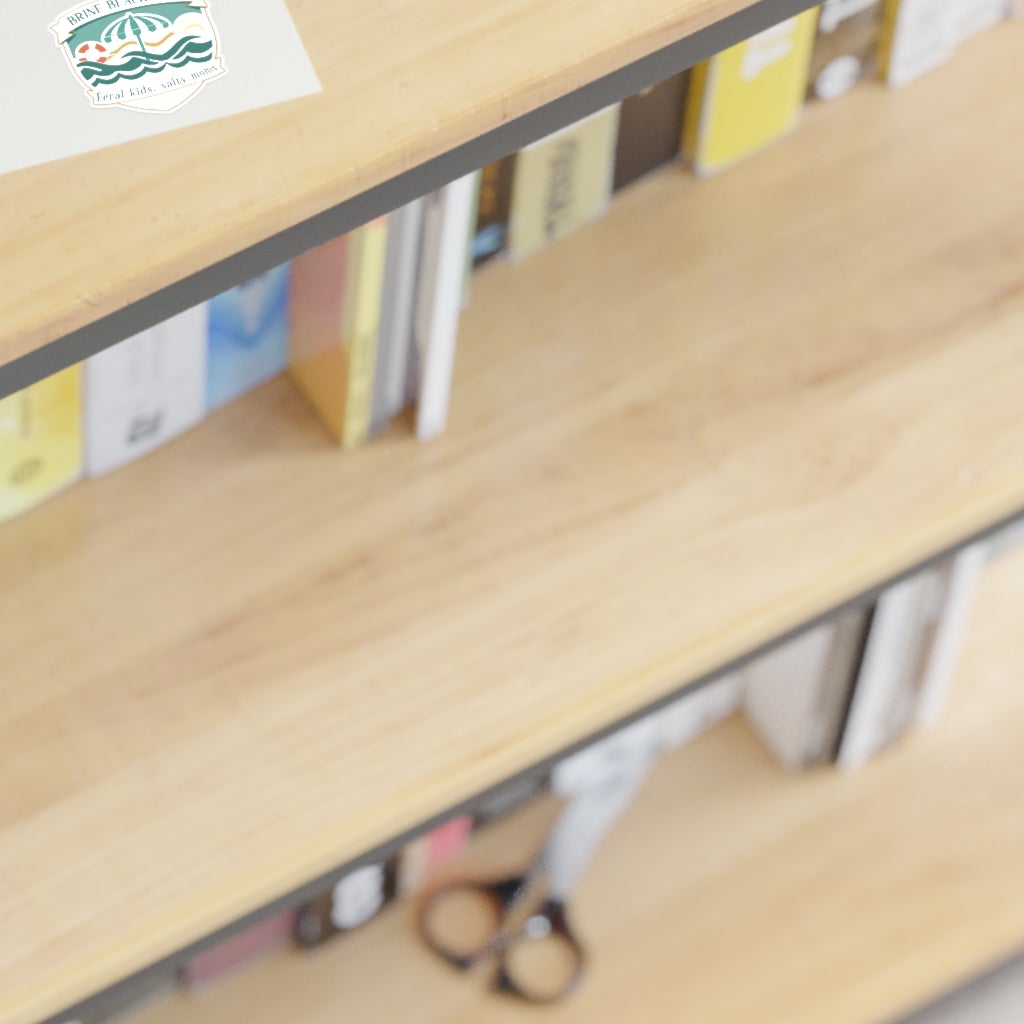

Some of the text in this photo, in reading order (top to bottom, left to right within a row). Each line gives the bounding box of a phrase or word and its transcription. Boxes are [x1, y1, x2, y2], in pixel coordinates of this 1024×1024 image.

[66, 3, 101, 26] BRINE
[96, 88, 125, 102] Feral
[161, 77, 187, 90] salty
[190, 65, 218, 80] moms
